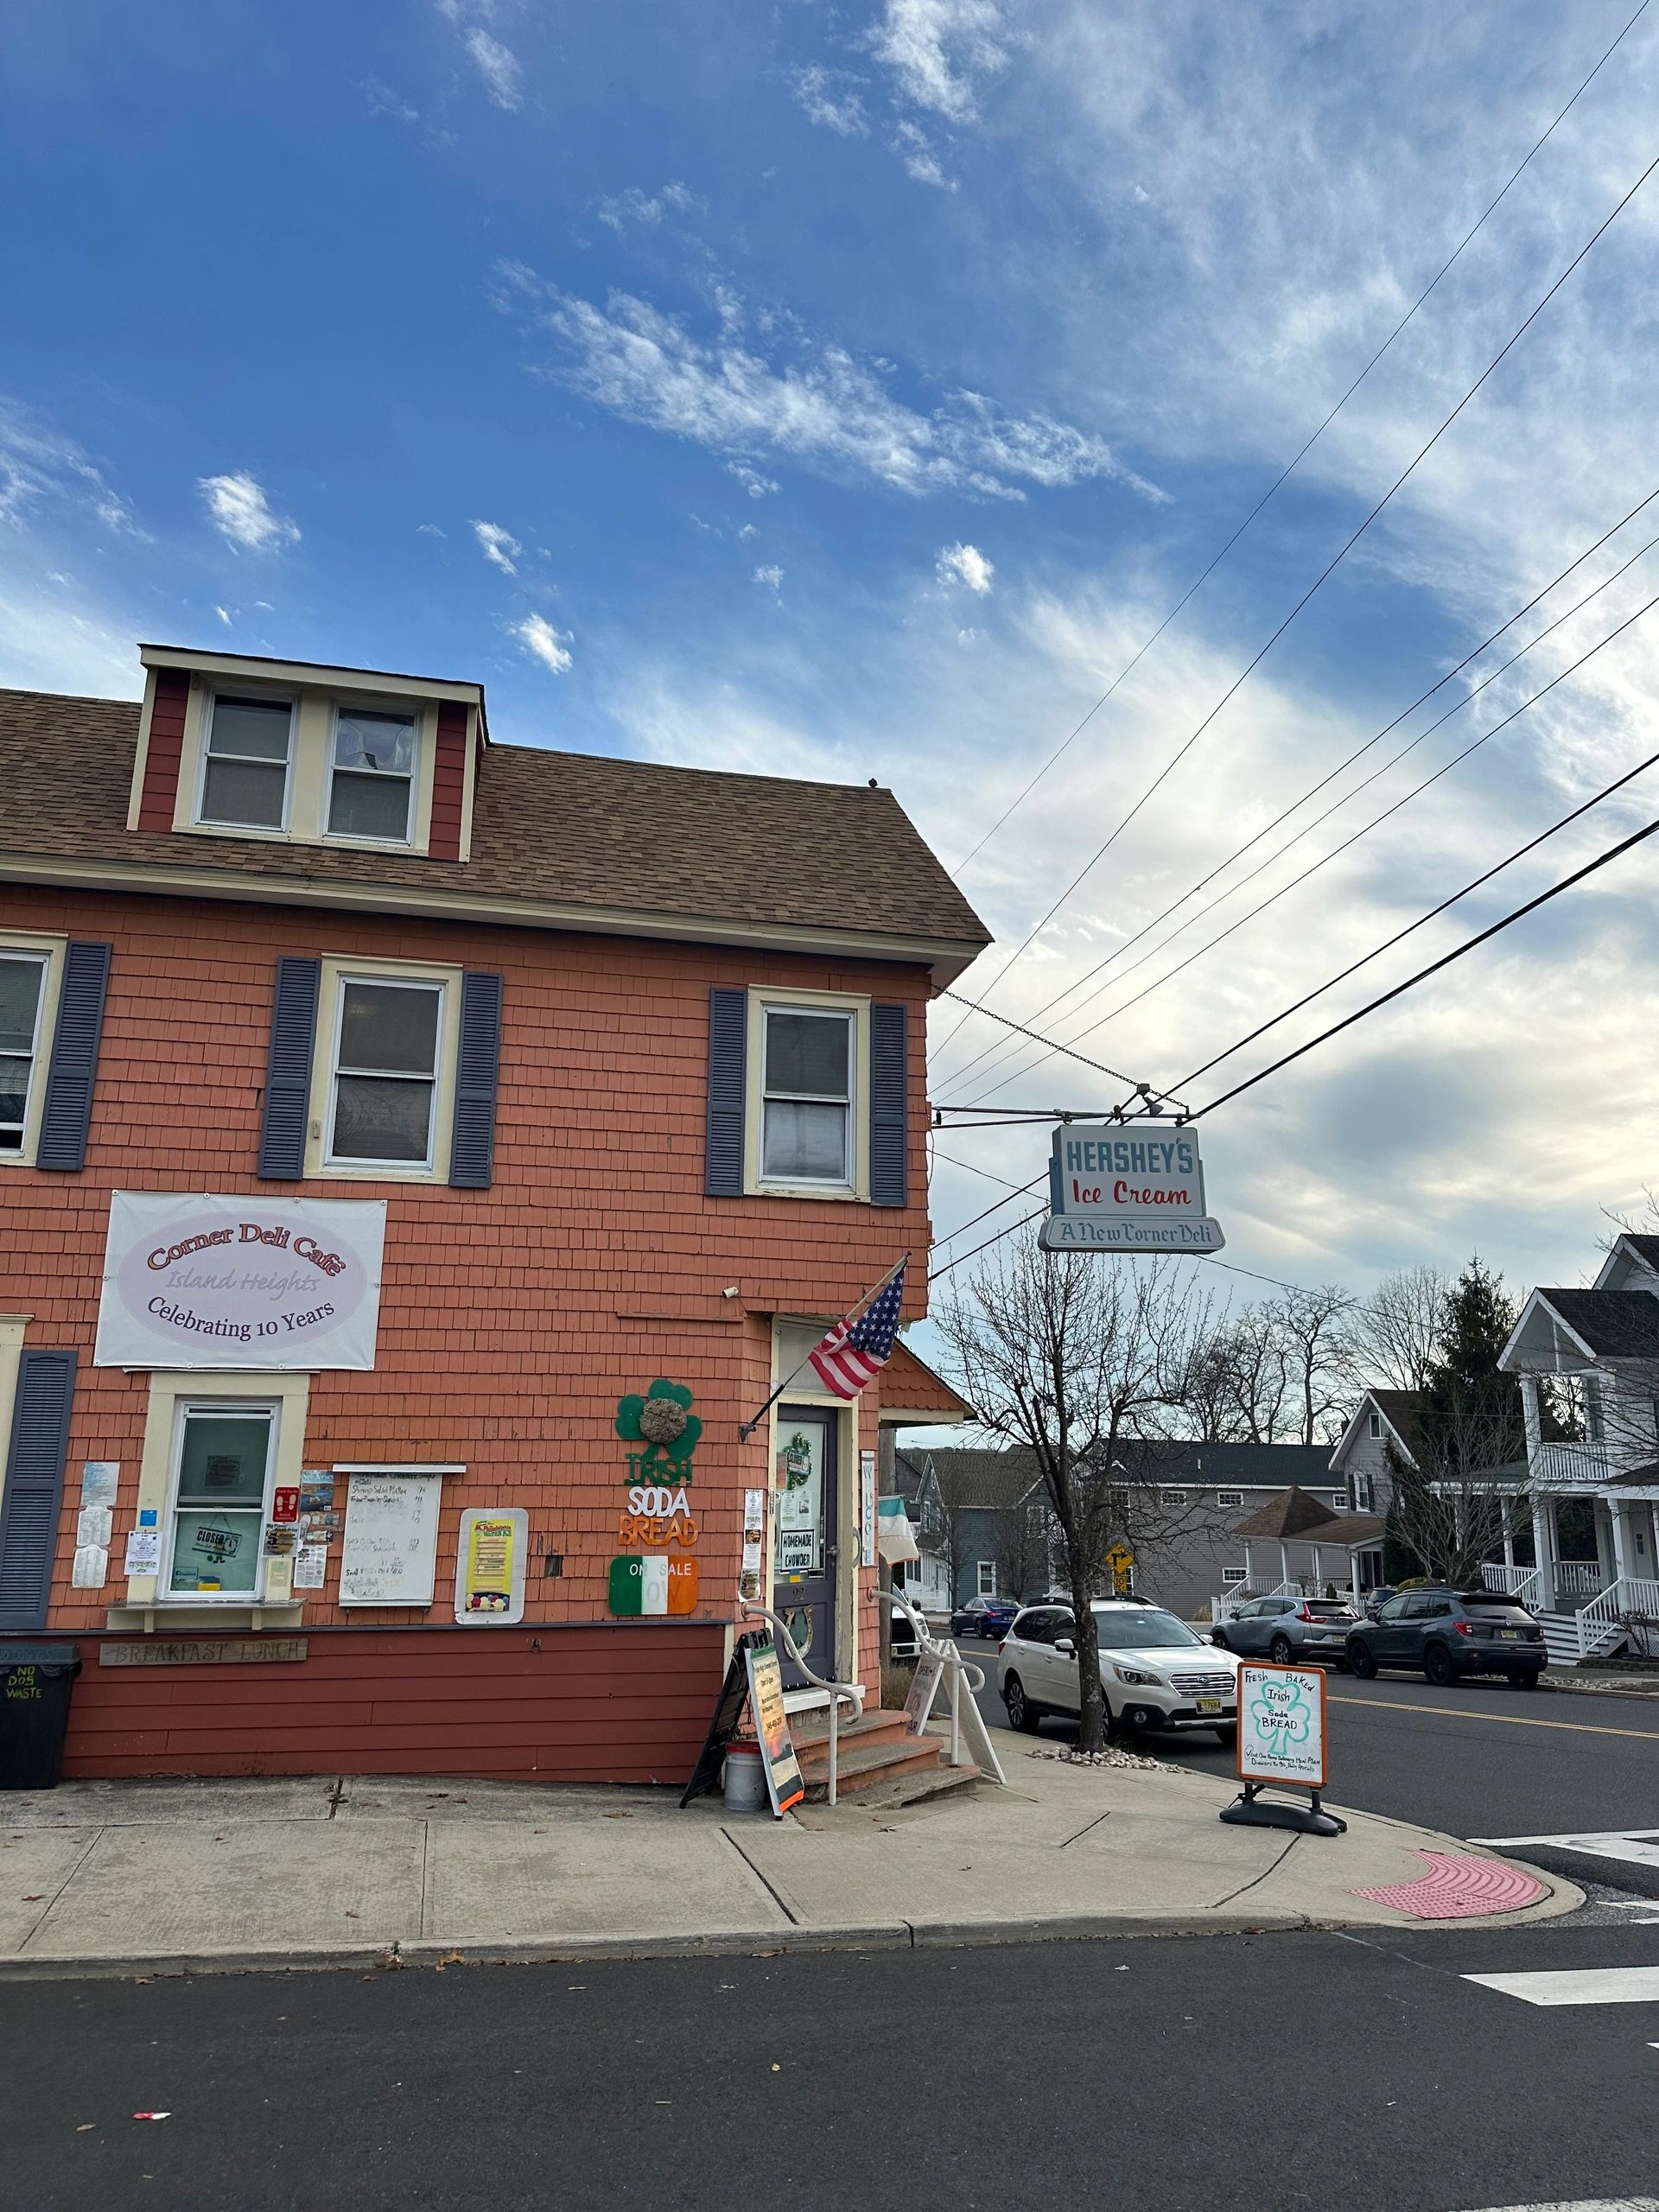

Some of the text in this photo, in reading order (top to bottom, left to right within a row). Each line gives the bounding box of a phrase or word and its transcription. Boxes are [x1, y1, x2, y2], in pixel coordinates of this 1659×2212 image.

[1067, 1137, 1193, 1173] HERSHEY'S
[1073, 1179, 1192, 1205] Ice Cream
[1060, 1223, 1211, 1243] A New Corner Deli
[147, 1228, 234, 1271] Corner
[238, 1224, 291, 1249] Deli
[166, 1268, 321, 1300] Island Heights
[148, 1296, 335, 1342] Celebrating 10 Years
[624, 1453, 692, 1485] IRISH
[627, 1486, 691, 1517] SODA
[197, 1530, 225, 1544] CLOSED
[618, 1515, 699, 1547] BREAD
[783, 1535, 812, 1548] HOMEMADE
[785, 1553, 810, 1567] CHOWDER
[629, 1563, 692, 1576] ON SALE
[793, 1587, 805, 1602] 22
[116, 1642, 300, 1663] BREAKFAST LUNCH
[17, 1666, 35, 1675] NO
[7, 1687, 42, 1699] WASTE
[1267, 1688, 1290, 1702] Irish
[1268, 1709, 1289, 1718] Soda
[1262, 1718, 1298, 1729] BREAD
